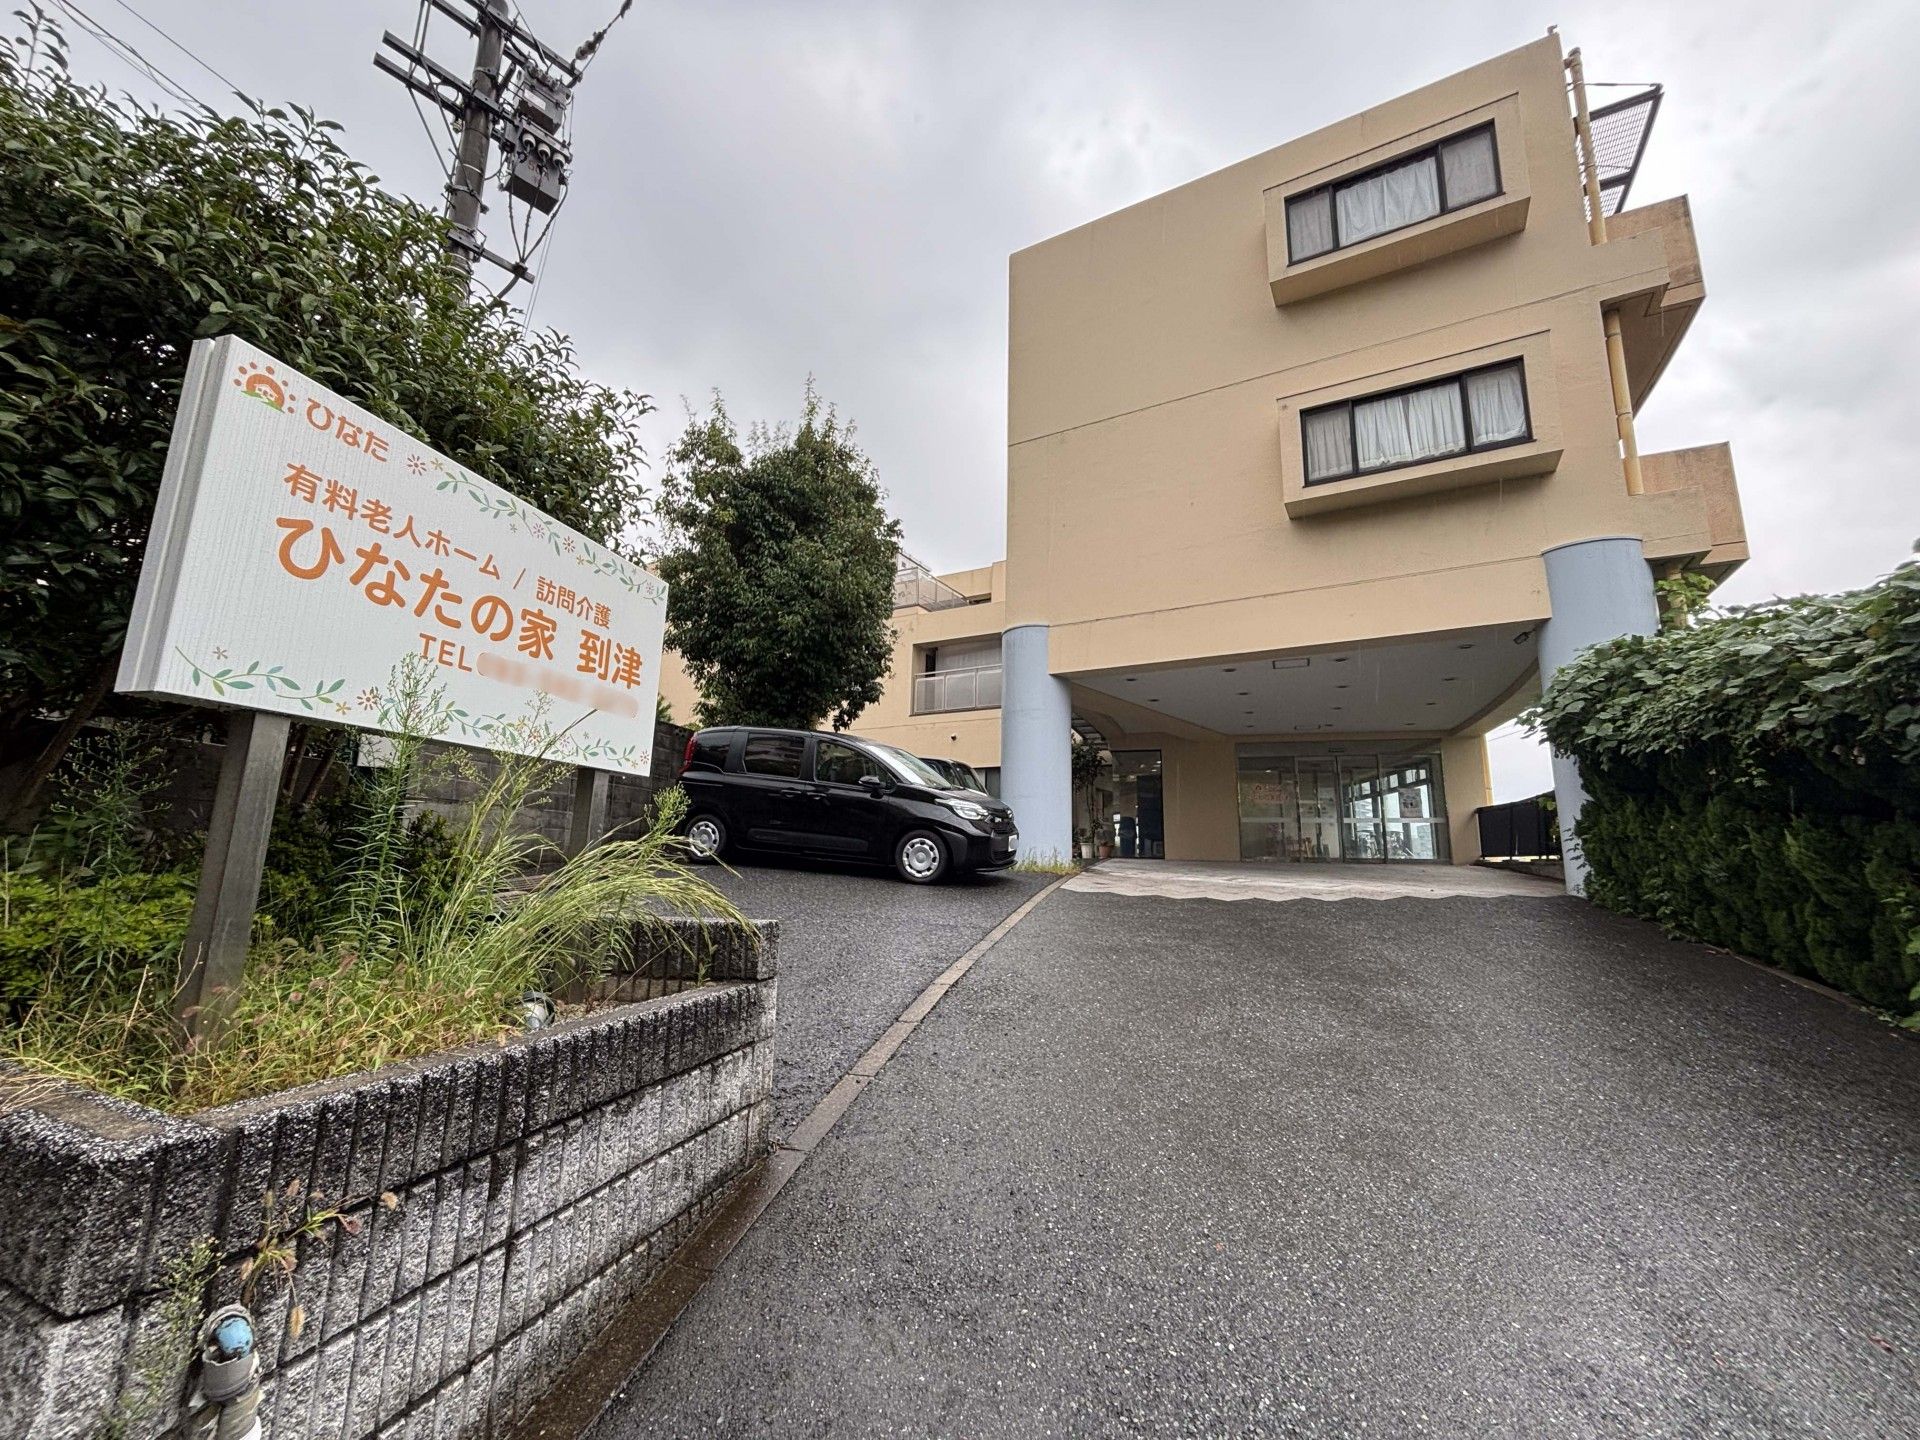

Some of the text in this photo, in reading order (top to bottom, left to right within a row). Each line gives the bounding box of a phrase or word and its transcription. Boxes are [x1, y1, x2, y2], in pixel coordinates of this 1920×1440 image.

[305, 398, 389, 463] ひなた
[275, 516, 558, 661] ひなたの家
[576, 628, 644, 690] 到津
[284, 463, 502, 581] 有料老人ホーム
[536, 575, 612, 630] 訪問介護
[419, 633, 474, 673] TEL
